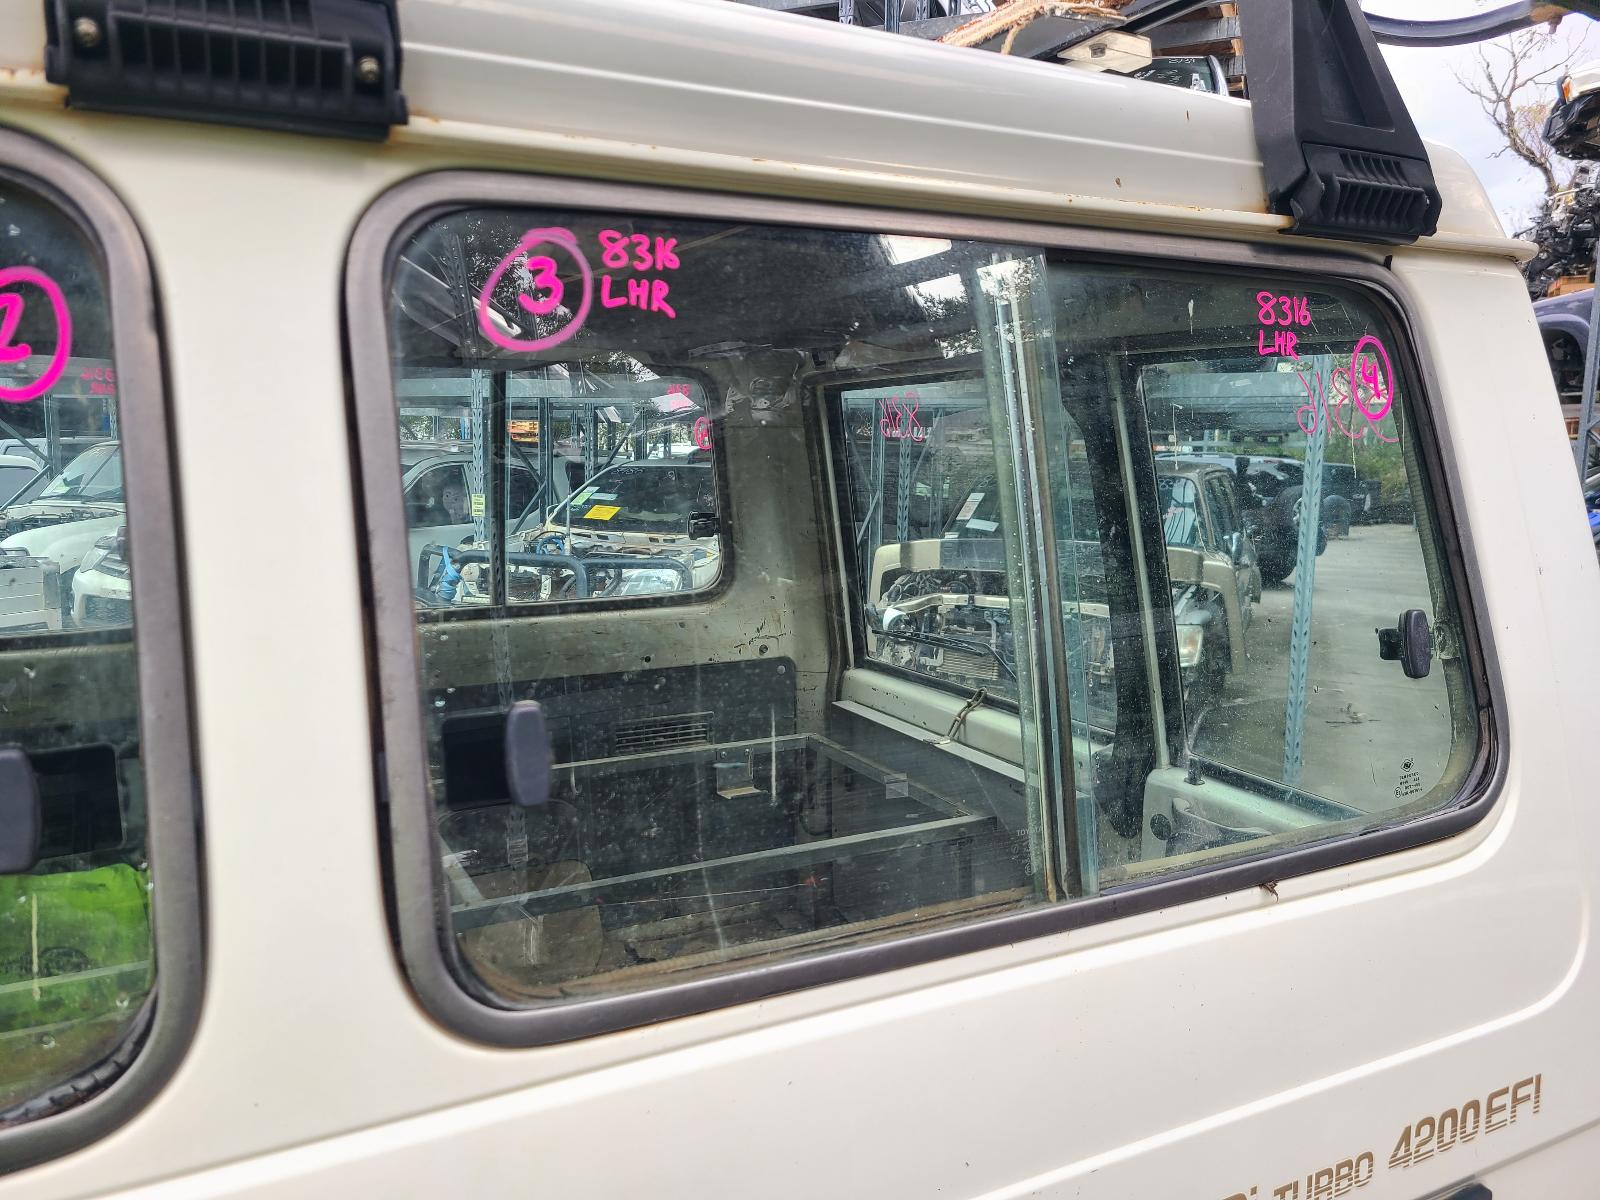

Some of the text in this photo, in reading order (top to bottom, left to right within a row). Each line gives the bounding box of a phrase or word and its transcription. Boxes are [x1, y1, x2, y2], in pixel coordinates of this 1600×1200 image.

[518, 256, 564, 315] 3
[601, 274, 676, 320] LHR
[1256, 291, 1312, 326] 8316
[1258, 330, 1300, 360] LHR
[1361, 355, 1381, 400] 4
